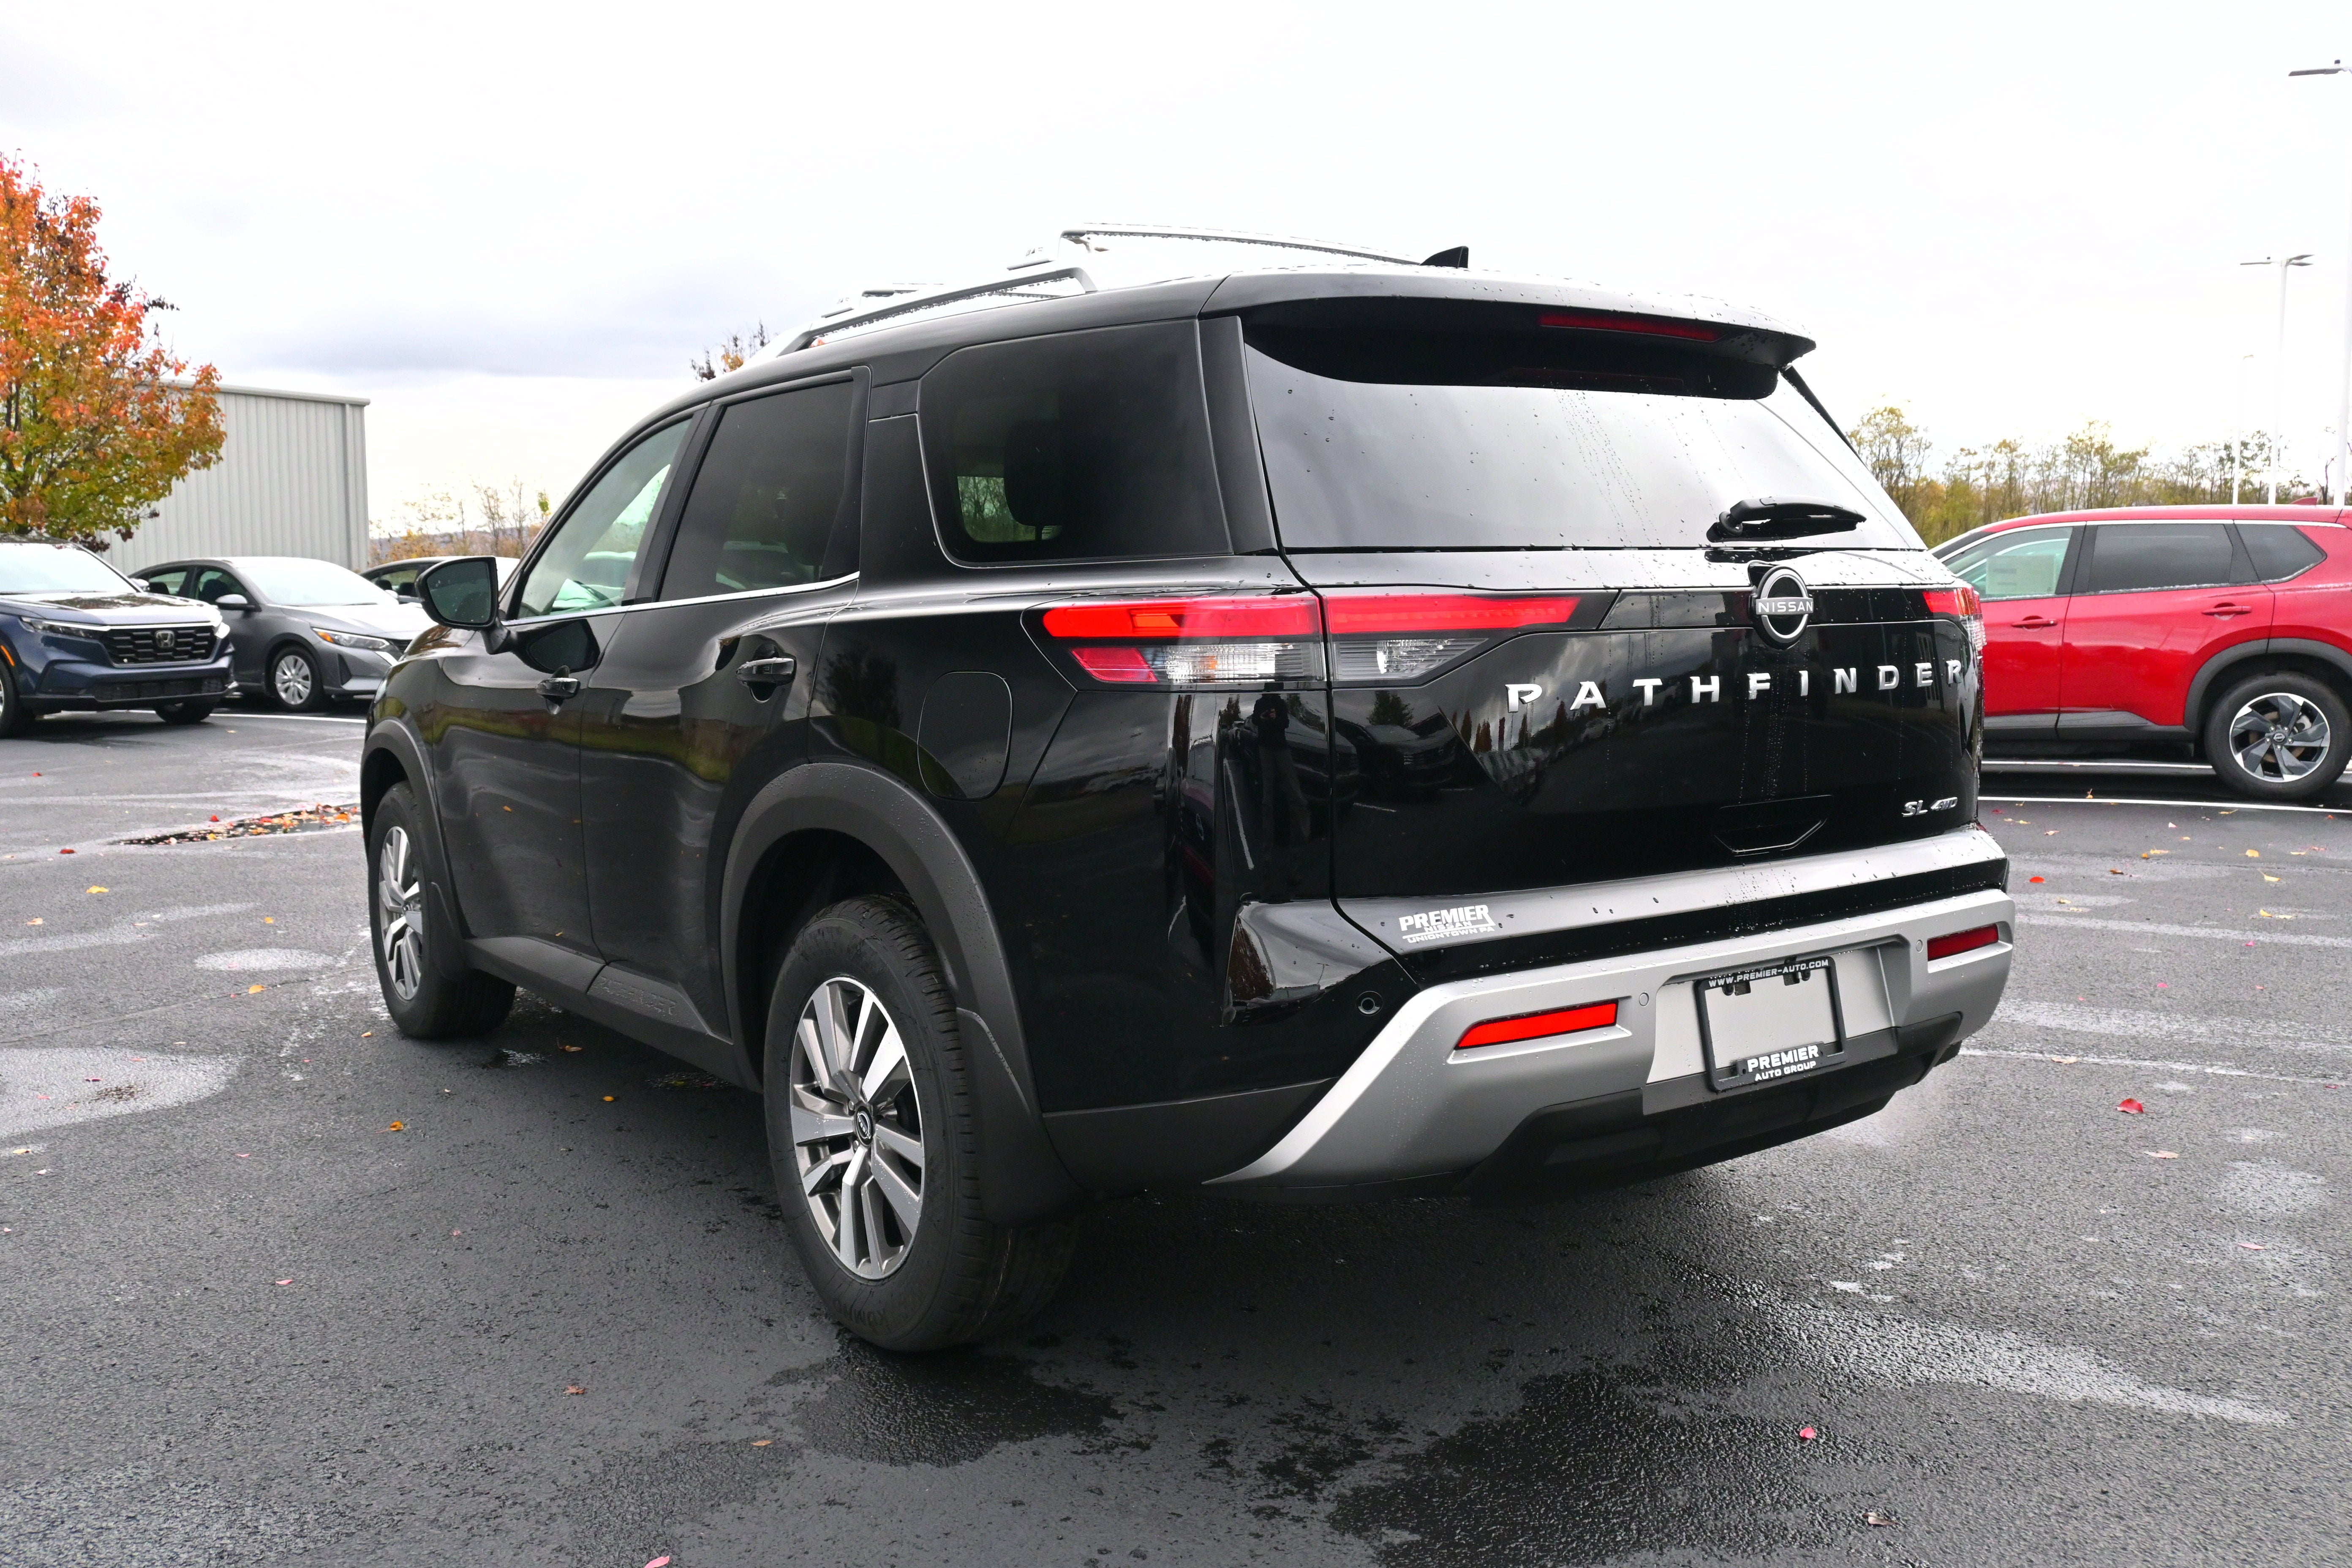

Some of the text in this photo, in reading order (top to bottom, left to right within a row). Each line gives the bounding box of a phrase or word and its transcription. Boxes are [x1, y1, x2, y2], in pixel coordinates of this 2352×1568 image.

[1758, 601, 1813, 612] NISSAN
[1505, 659, 1962, 713] PATHFINDER
[1901, 800, 1928, 817] SL
[1399, 904, 1496, 931] PREMIER
[1424, 921, 1473, 932] NISSAN
[1407, 928, 1478, 943] UNIONTOWN
[1709, 959, 1829, 987] WWW.PREMIER-AUTO.COM
[1747, 1045, 1819, 1072] PREMIER
[1755, 1060, 1816, 1081] AUTO GROUP
